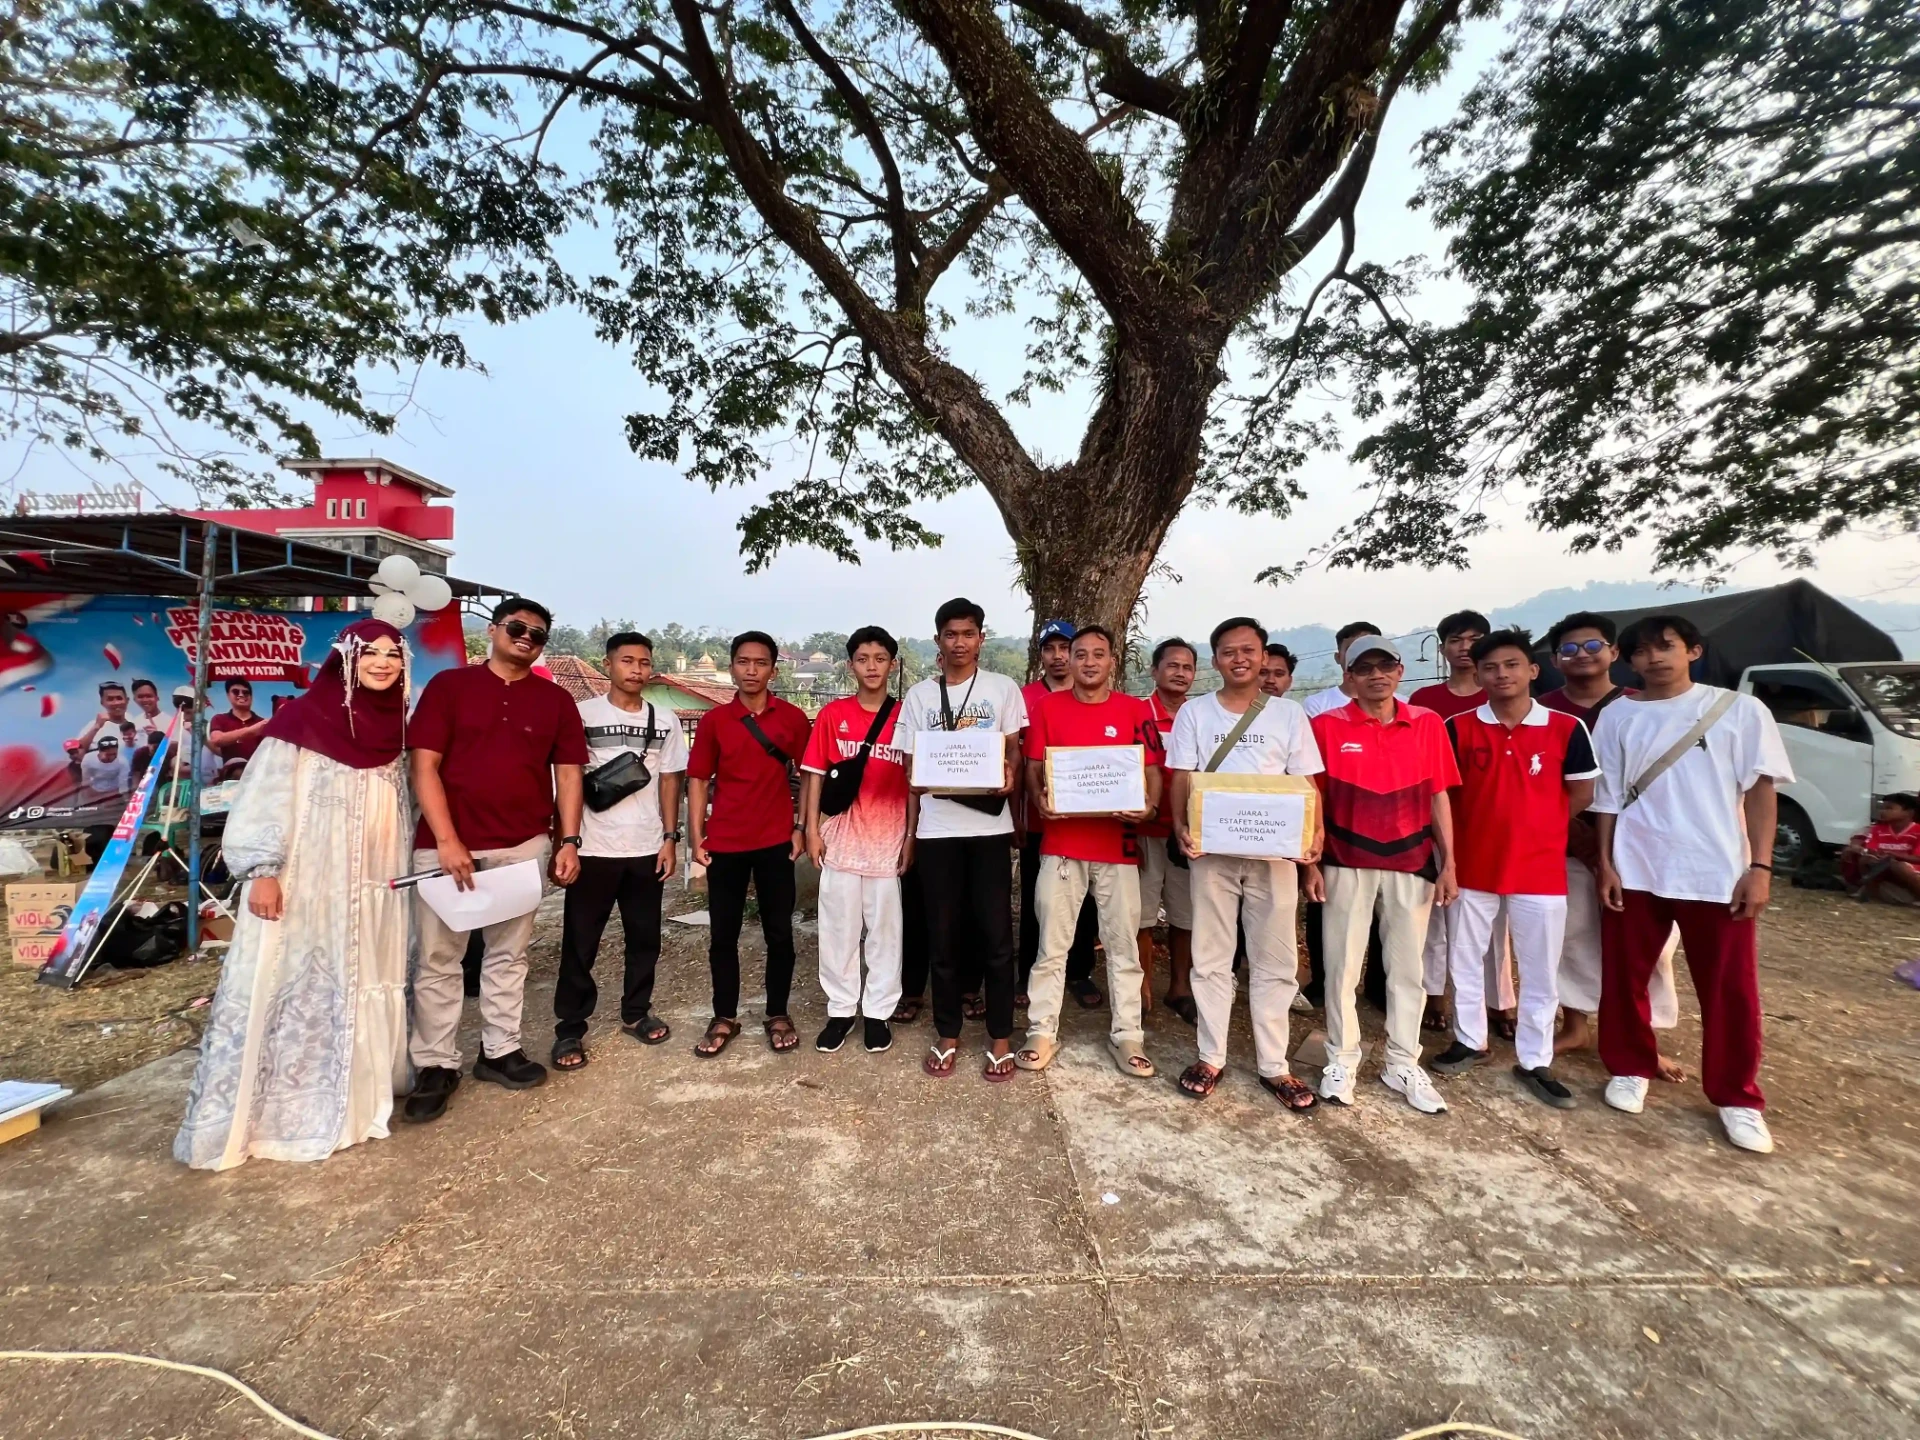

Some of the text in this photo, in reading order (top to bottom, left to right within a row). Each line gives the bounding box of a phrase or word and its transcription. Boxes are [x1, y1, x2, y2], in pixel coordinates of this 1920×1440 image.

[167, 609, 290, 627] BELOMBA
[289, 629, 304, 645] &
[215, 666, 285, 675] ANAK YATIM
[1099, 771, 1127, 779] SARUNG
[1219, 818, 1286, 827] ESTAFET SARUNG
[1228, 826, 1276, 834] GANDENGAN
[16, 912, 53, 926] VIOLA
